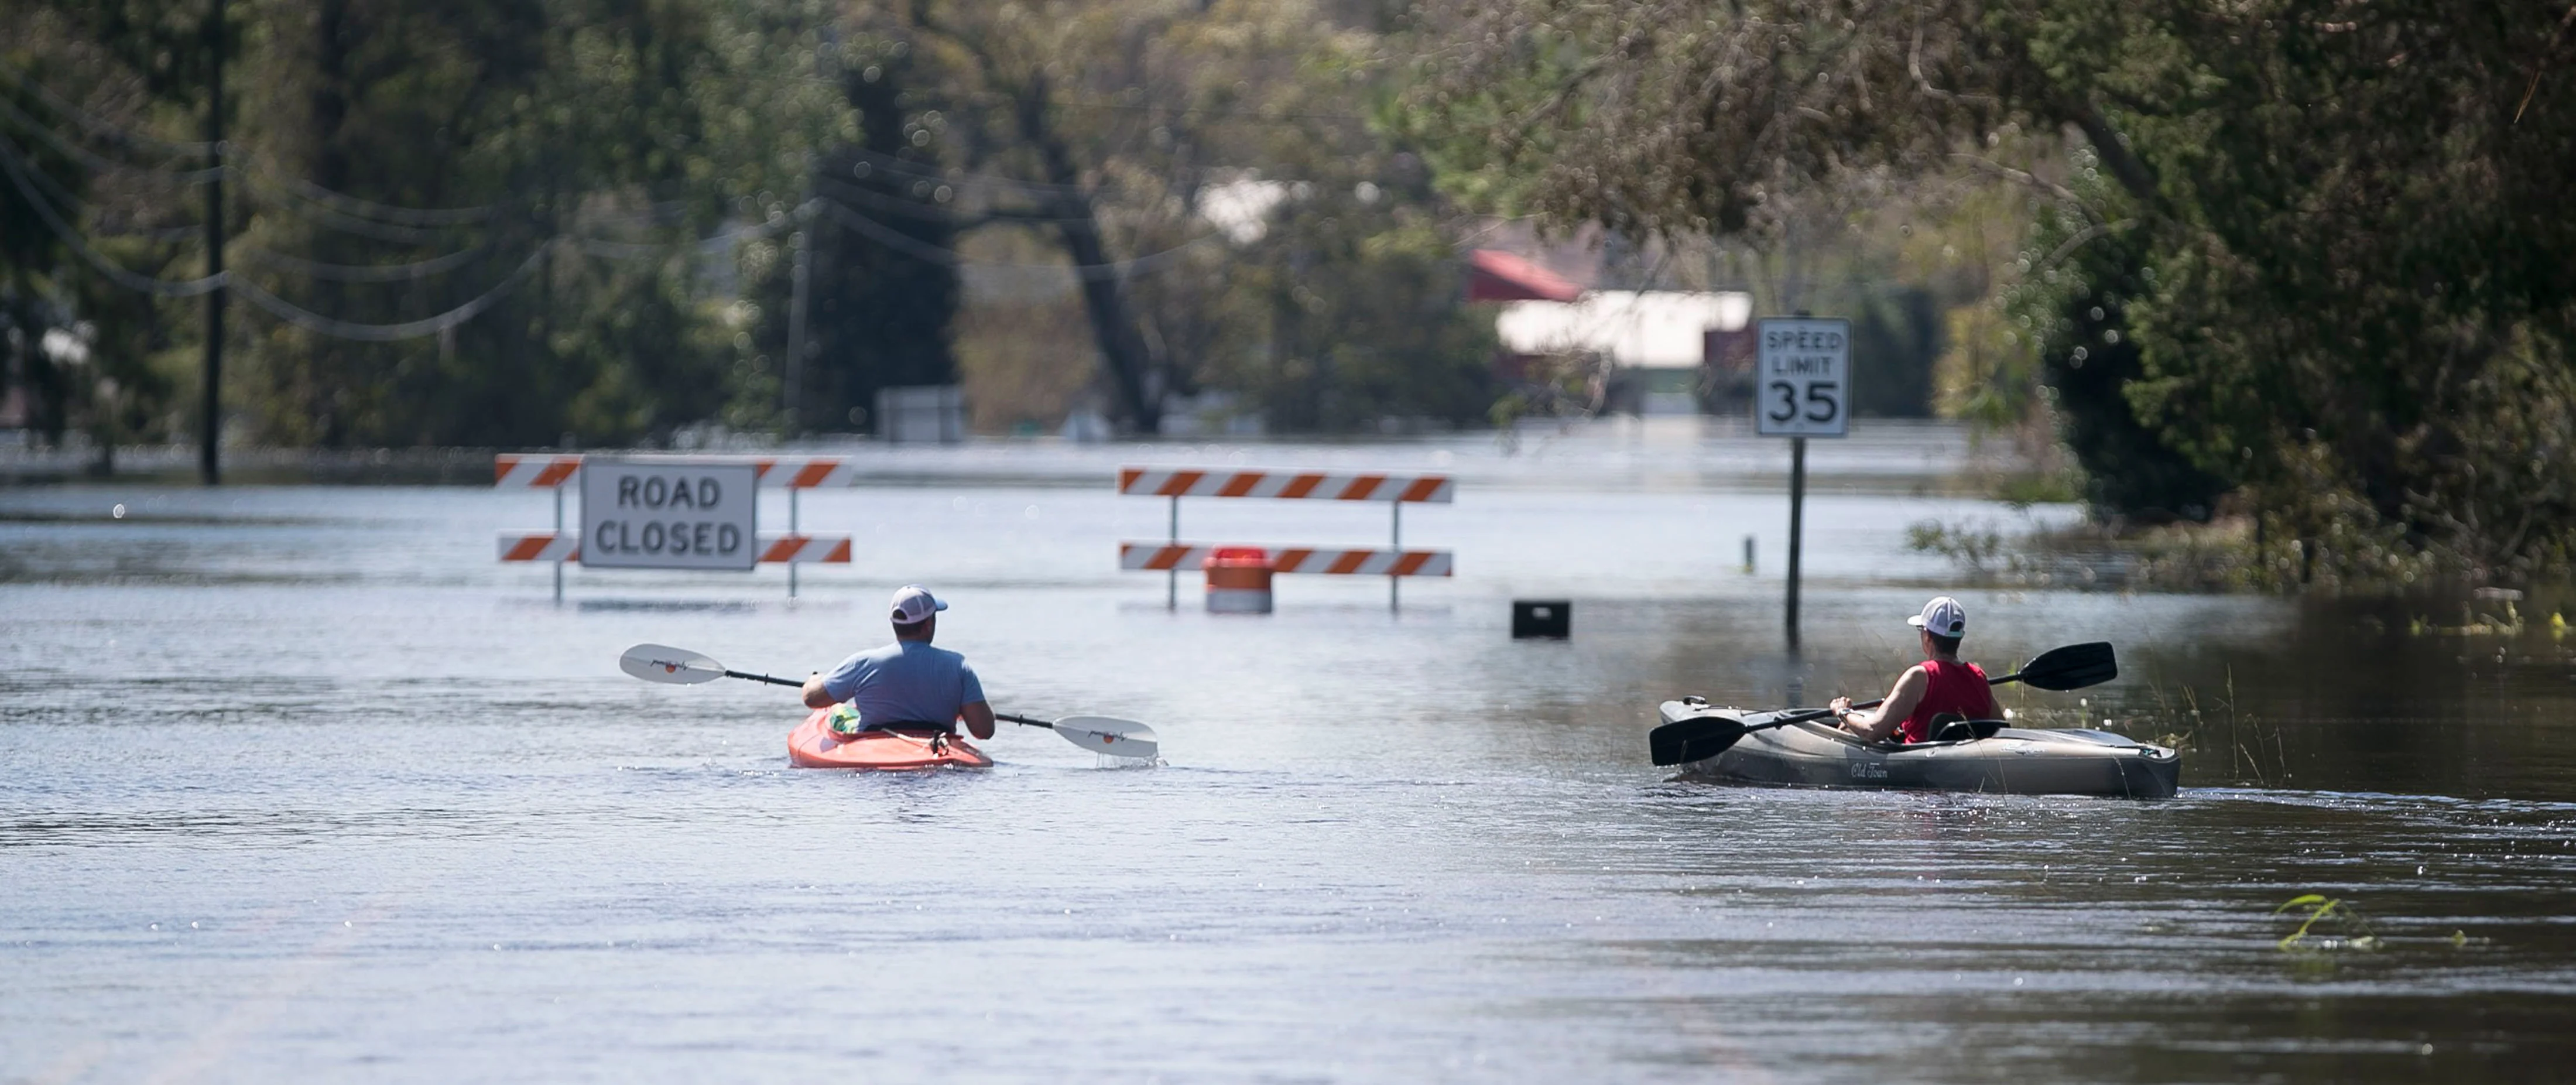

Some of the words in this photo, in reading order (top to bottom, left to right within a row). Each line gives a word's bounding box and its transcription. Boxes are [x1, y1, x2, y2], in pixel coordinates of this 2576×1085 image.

[1767, 331, 1842, 350] SPEED
[1772, 356, 1834, 375] LIMIT
[1768, 381, 1837, 423] 35
[618, 475, 721, 508] ROAD
[595, 519, 740, 555] CLOSED
